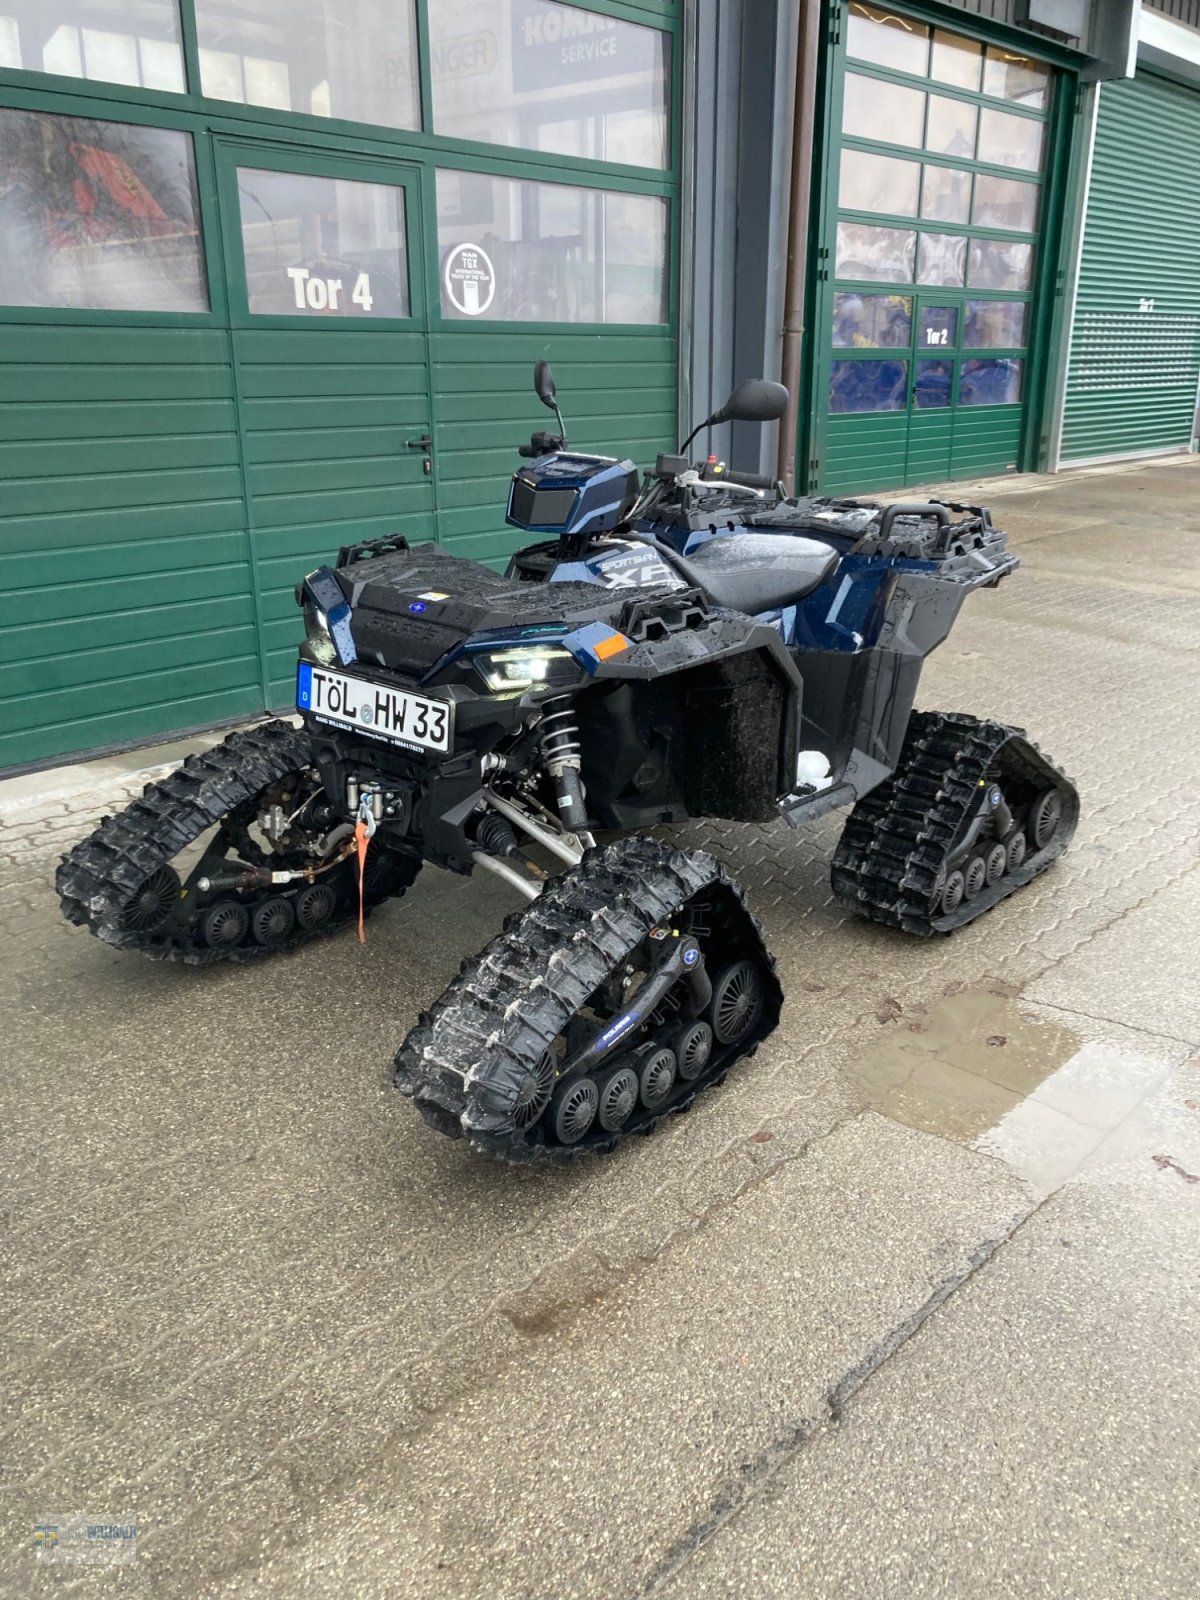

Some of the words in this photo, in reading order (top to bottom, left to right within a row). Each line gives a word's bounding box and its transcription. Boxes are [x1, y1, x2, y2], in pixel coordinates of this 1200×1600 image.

[561, 36, 617, 64] SERVICE
[462, 258, 478, 269] TGX
[287, 267, 342, 310] Tor
[352, 273, 374, 312] 4
[926, 327, 941, 345] Tor
[940, 328, 948, 345] 2
[601, 552, 658, 573] SPORTSMAN
[302, 691, 308, 701] D
[313, 673, 356, 718] TÖL
[375, 690, 407, 732] HW
[413, 702, 446, 743] 33
[602, 1015, 631, 1041] POLARIS
